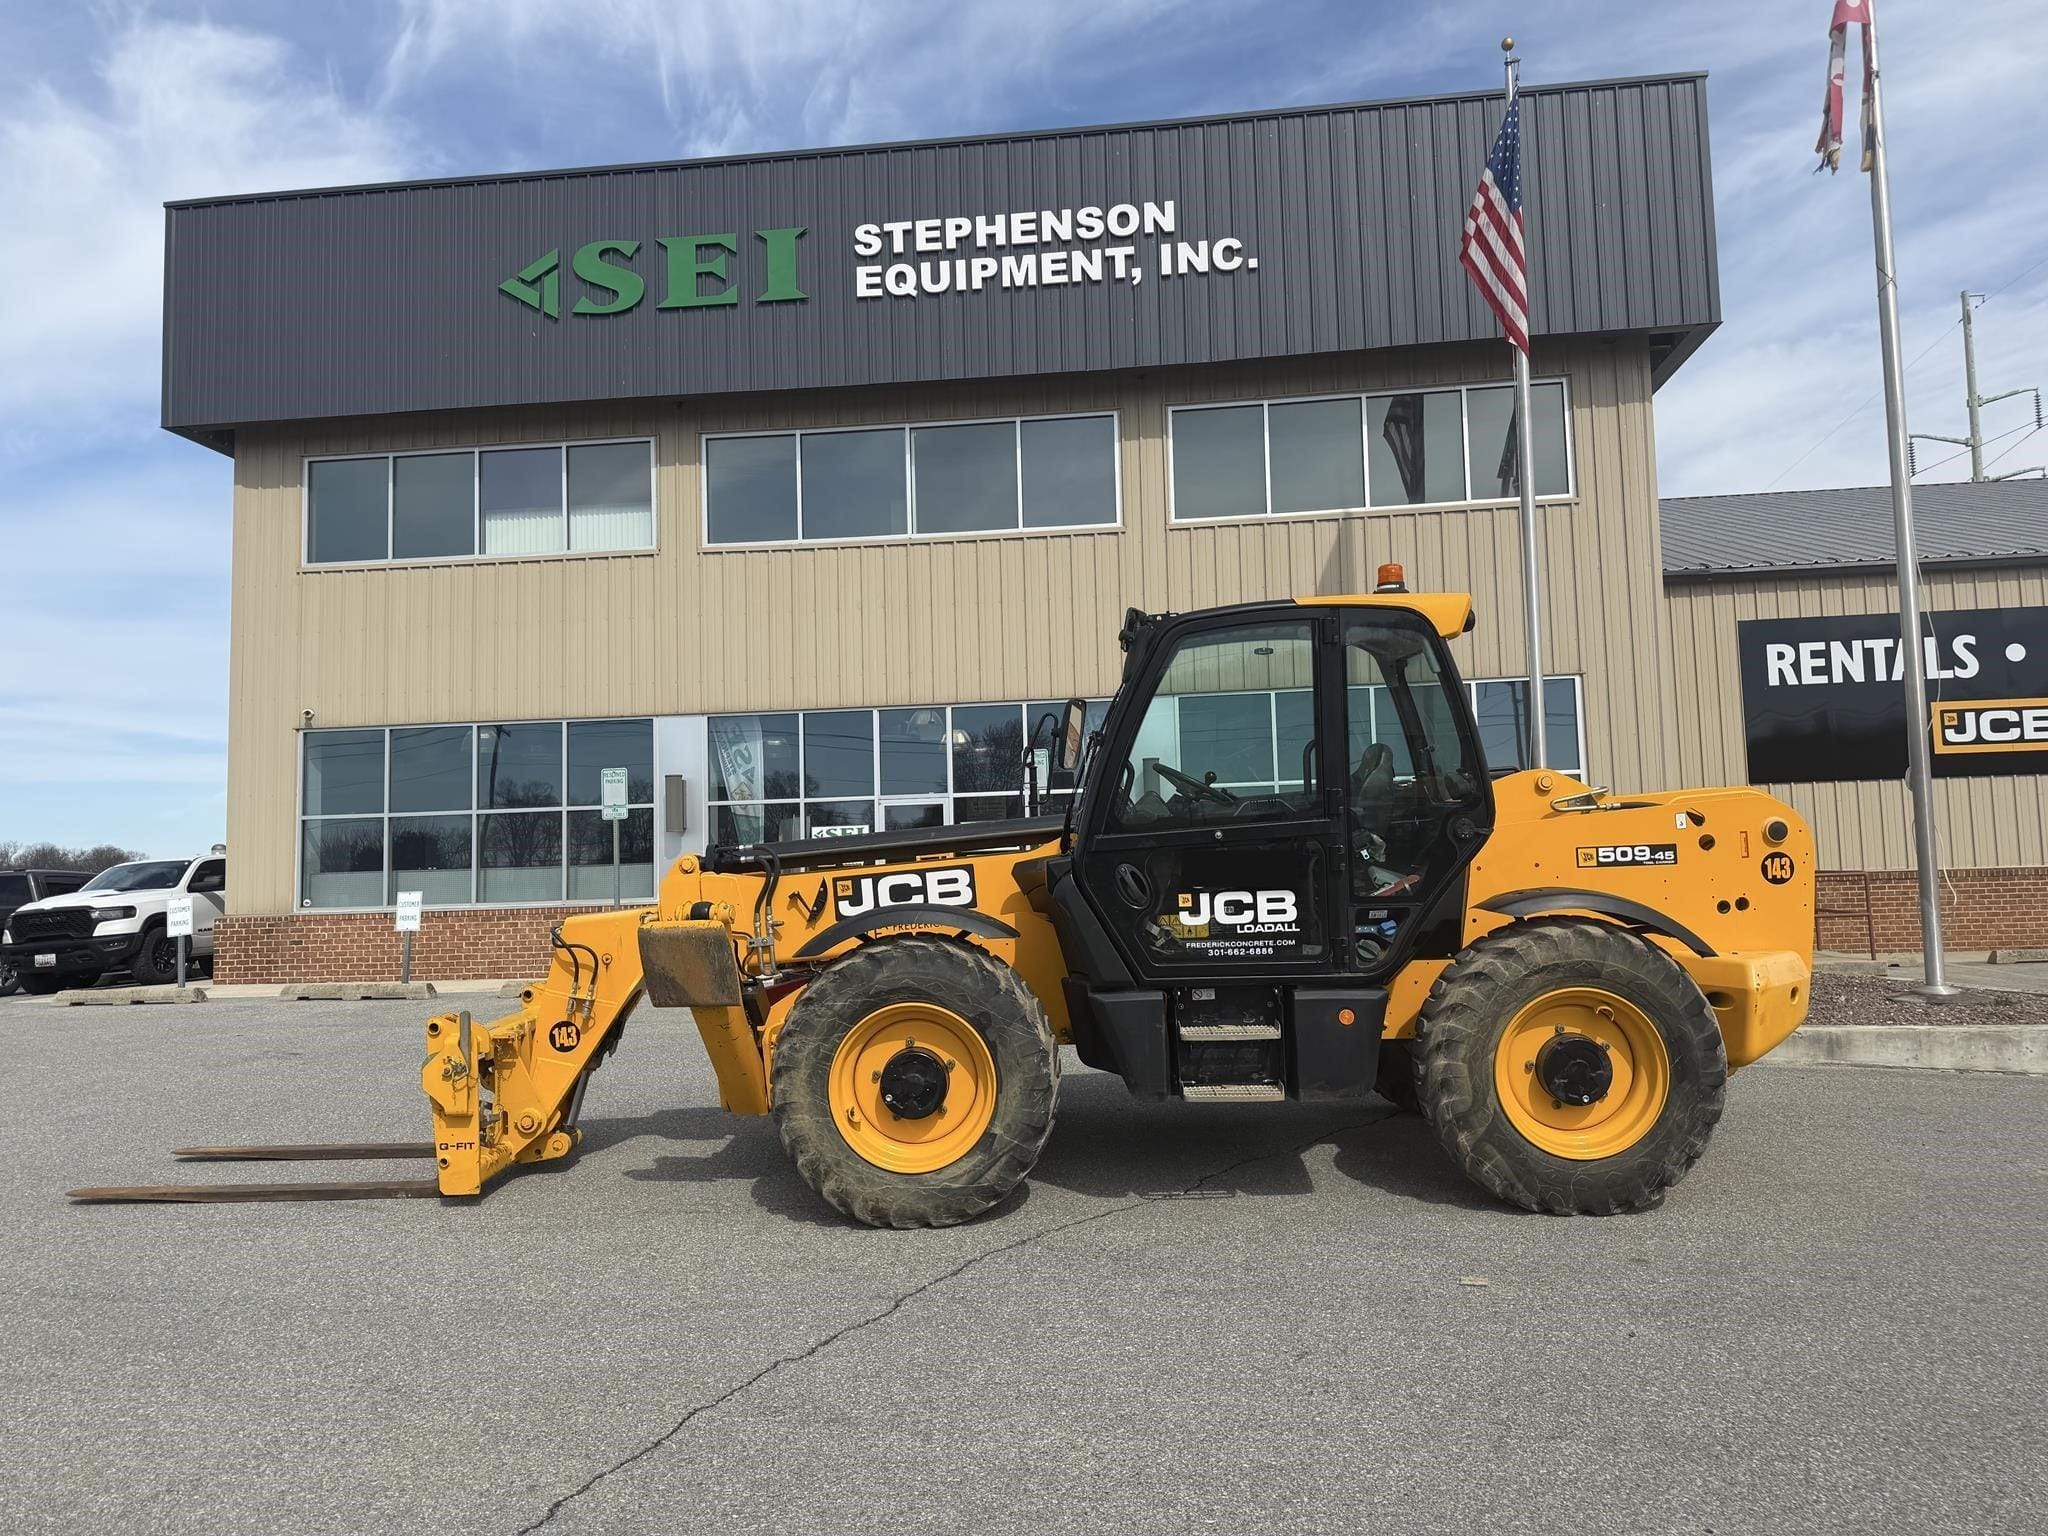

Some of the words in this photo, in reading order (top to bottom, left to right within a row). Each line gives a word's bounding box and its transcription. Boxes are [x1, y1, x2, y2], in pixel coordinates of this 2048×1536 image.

[854, 200, 1175, 256] STEPHENSON
[572, 227, 810, 315] SEI
[855, 246, 1143, 299] EQUIPMENT,
[1160, 237, 1259, 276] INC.
[1598, 846, 1675, 862] 509-45
[1765, 857, 1791, 880] 143
[838, 869, 973, 917] JCB
[1179, 890, 1297, 925] JCB
[1237, 923, 1300, 933] LOADALL
[1186, 940, 1295, 948] FREDERICKCONCRETE.COM
[552, 1026, 577, 1048] 143
[439, 1142, 475, 1151] Q-FIT
